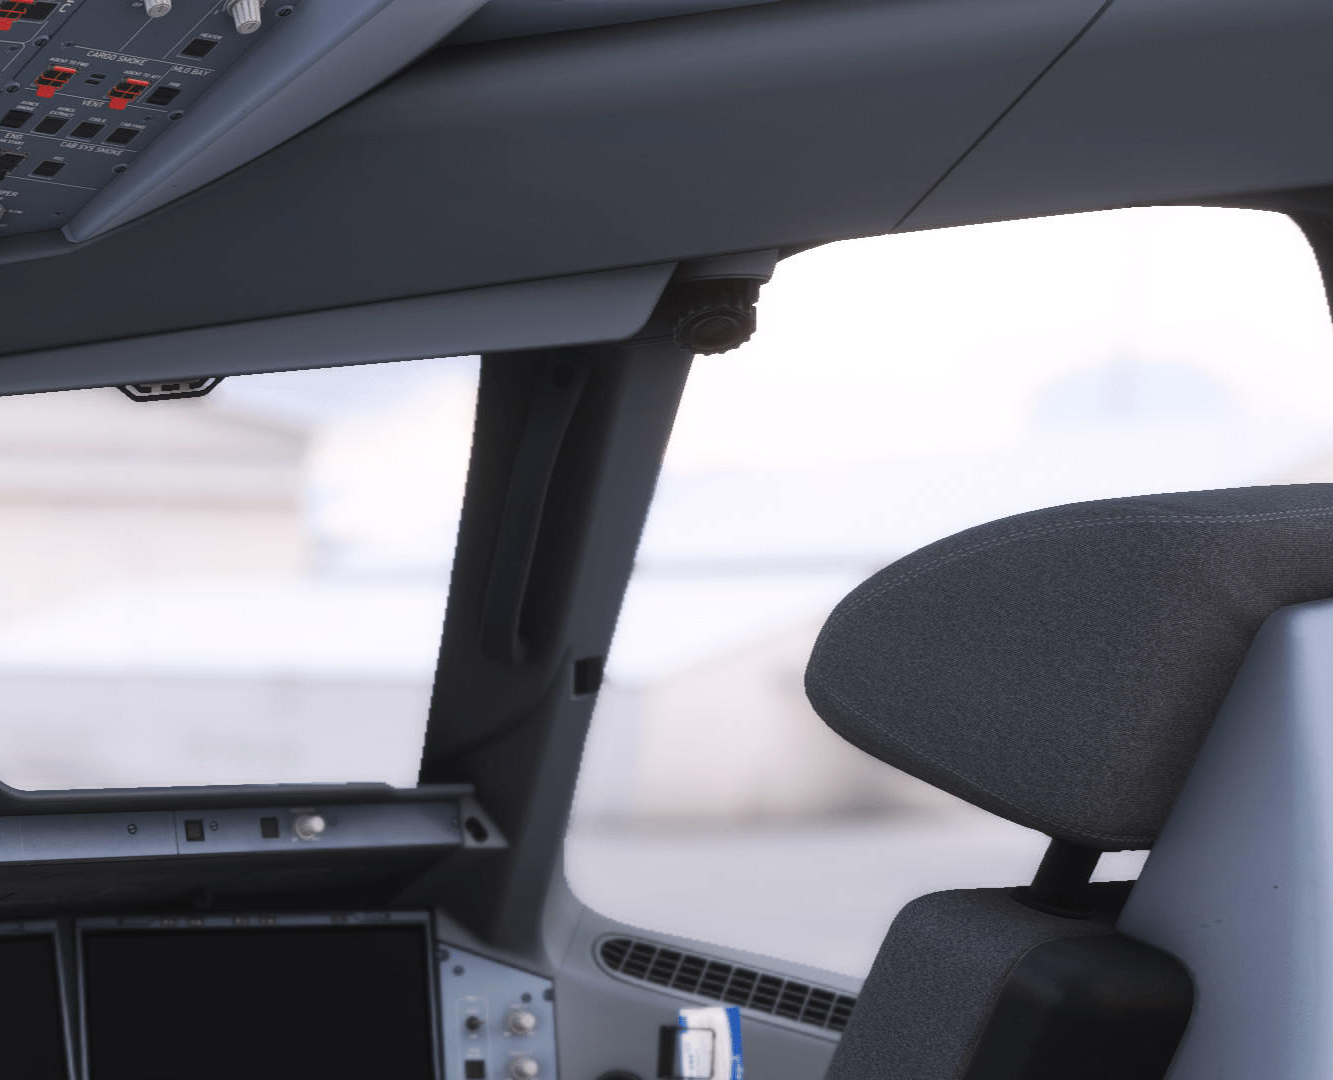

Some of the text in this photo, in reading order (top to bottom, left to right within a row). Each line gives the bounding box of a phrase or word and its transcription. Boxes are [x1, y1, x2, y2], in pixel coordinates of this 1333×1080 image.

[199, 32, 223, 40] HEATER
[48, 56, 67, 64] AGENT
[86, 50, 148, 66] CARGO SMOKE
[173, 65, 212, 77] MLG BAY
[81, 99, 106, 108] VENT
[4, 131, 24, 141] ENG
[59, 141, 77, 150] CAB
[94, 146, 123, 157] SMOKE
